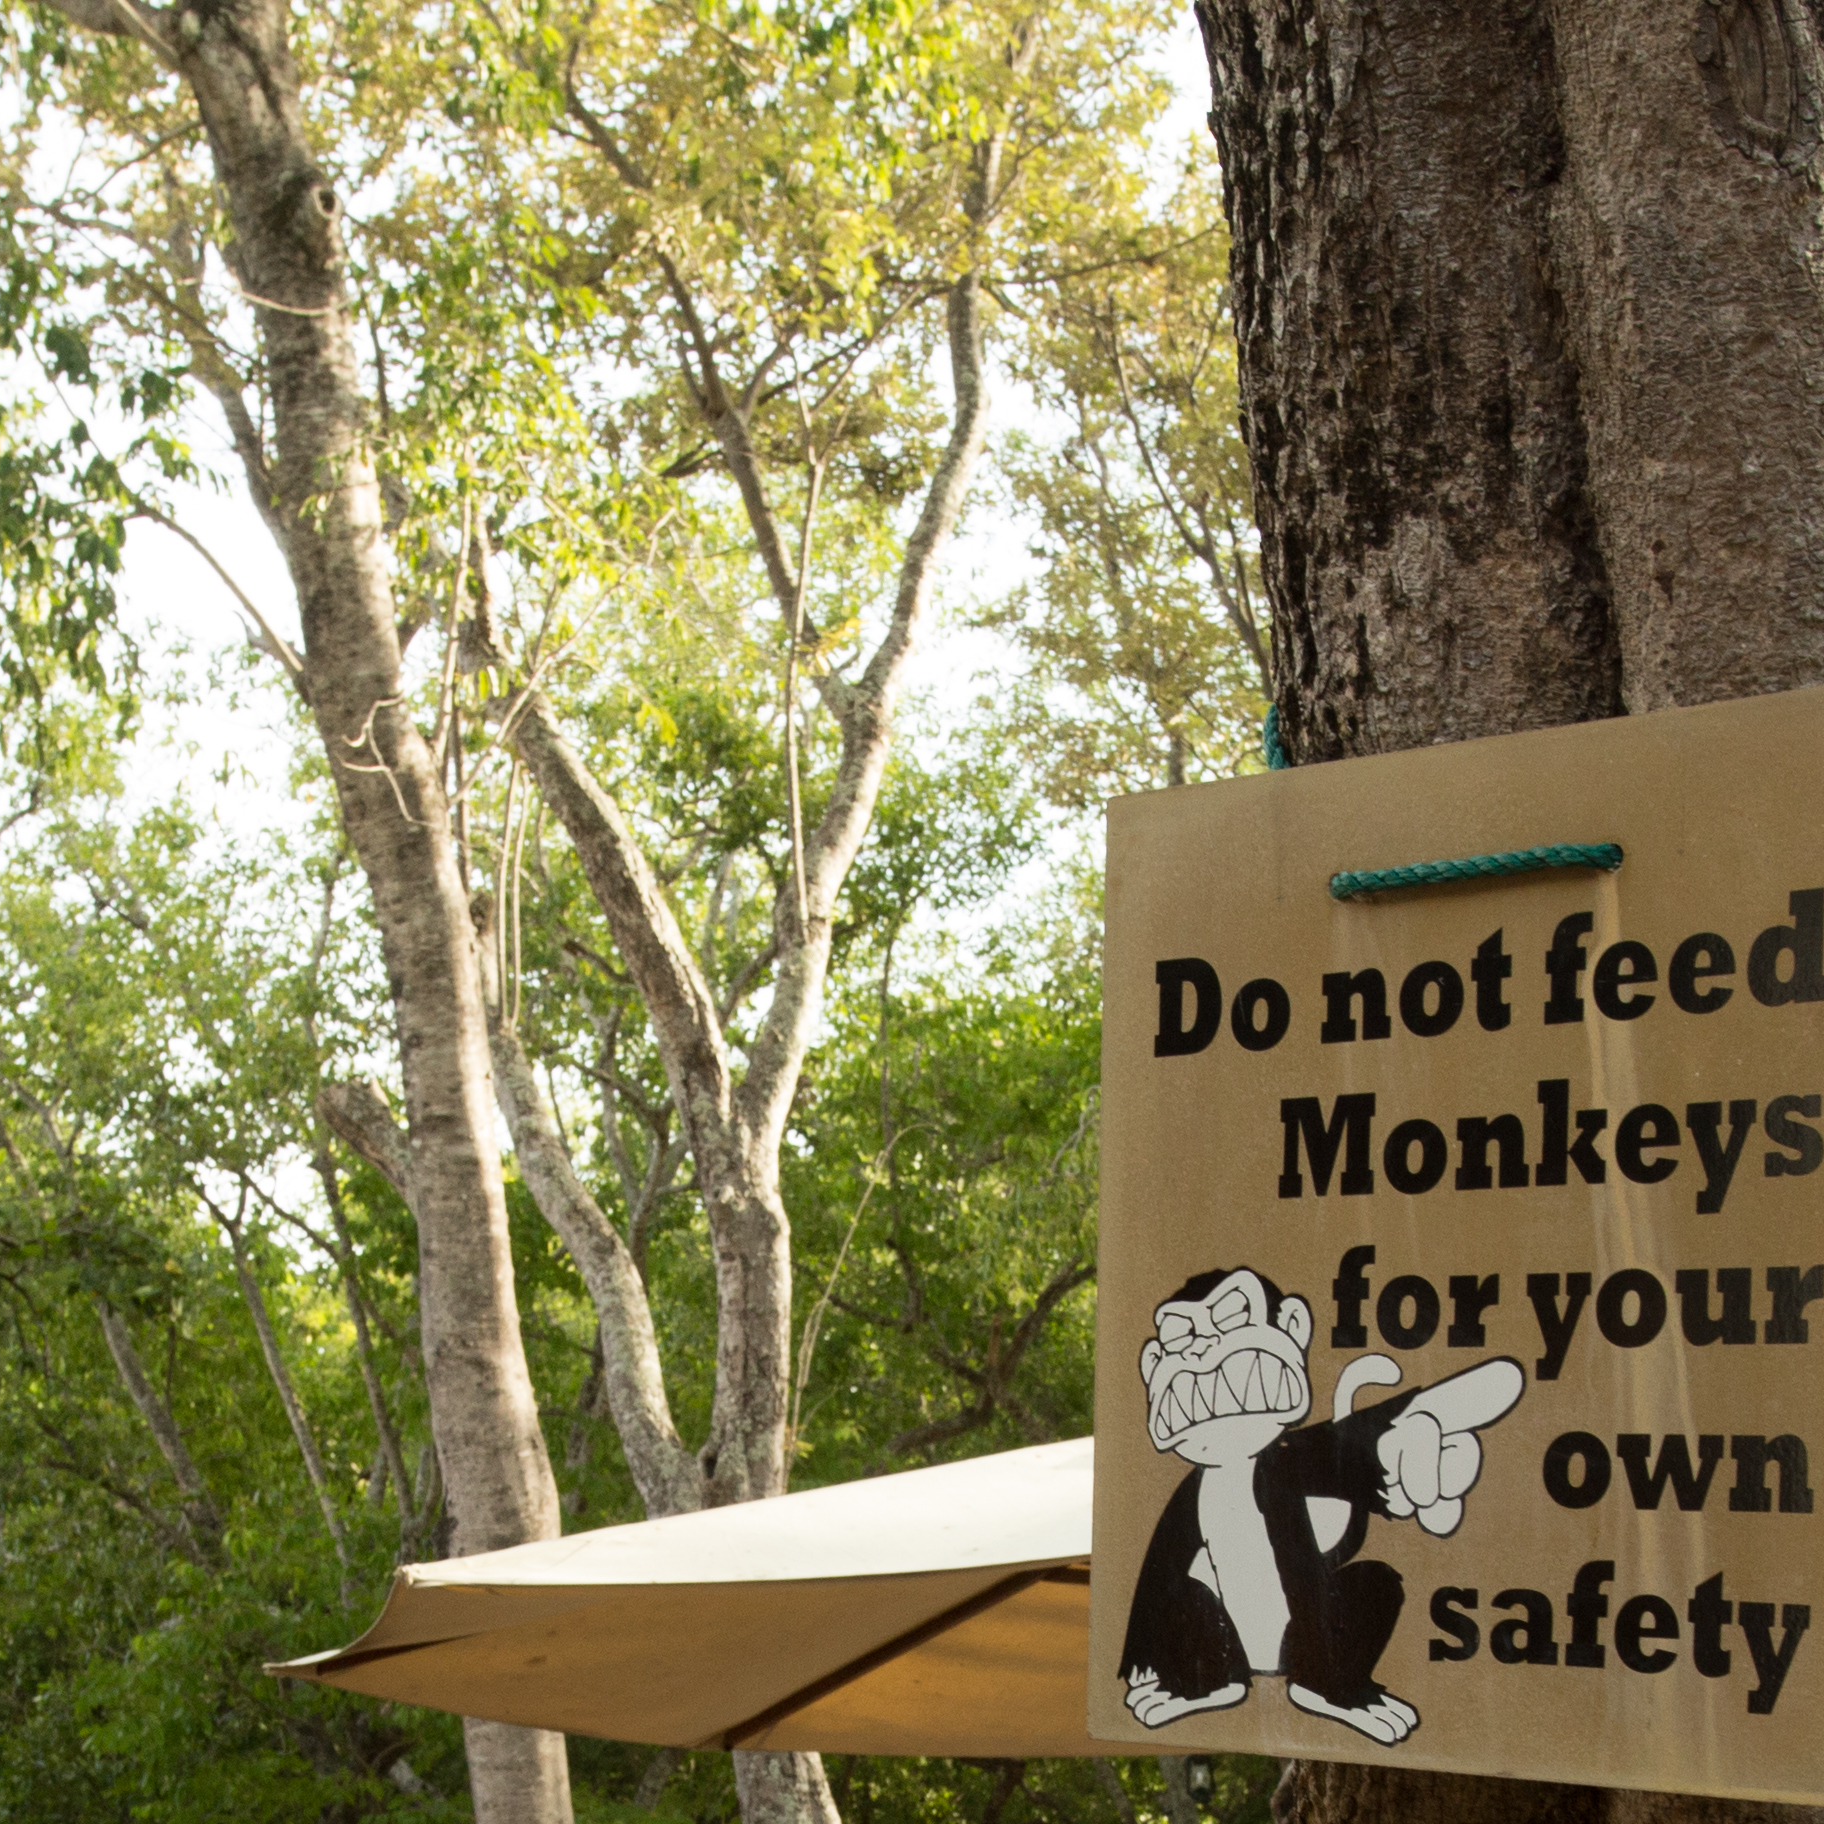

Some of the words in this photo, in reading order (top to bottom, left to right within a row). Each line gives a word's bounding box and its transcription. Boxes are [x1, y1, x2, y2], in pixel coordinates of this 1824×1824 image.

[1154, 957, 1290, 1058] Do
[1320, 928, 1512, 1045] not
[1278, 1079, 1824, 1215] Monkeys
[1331, 1245, 1500, 1351] for
[1542, 1430, 1815, 1515] own
[1428, 1559, 1811, 1715] safety
